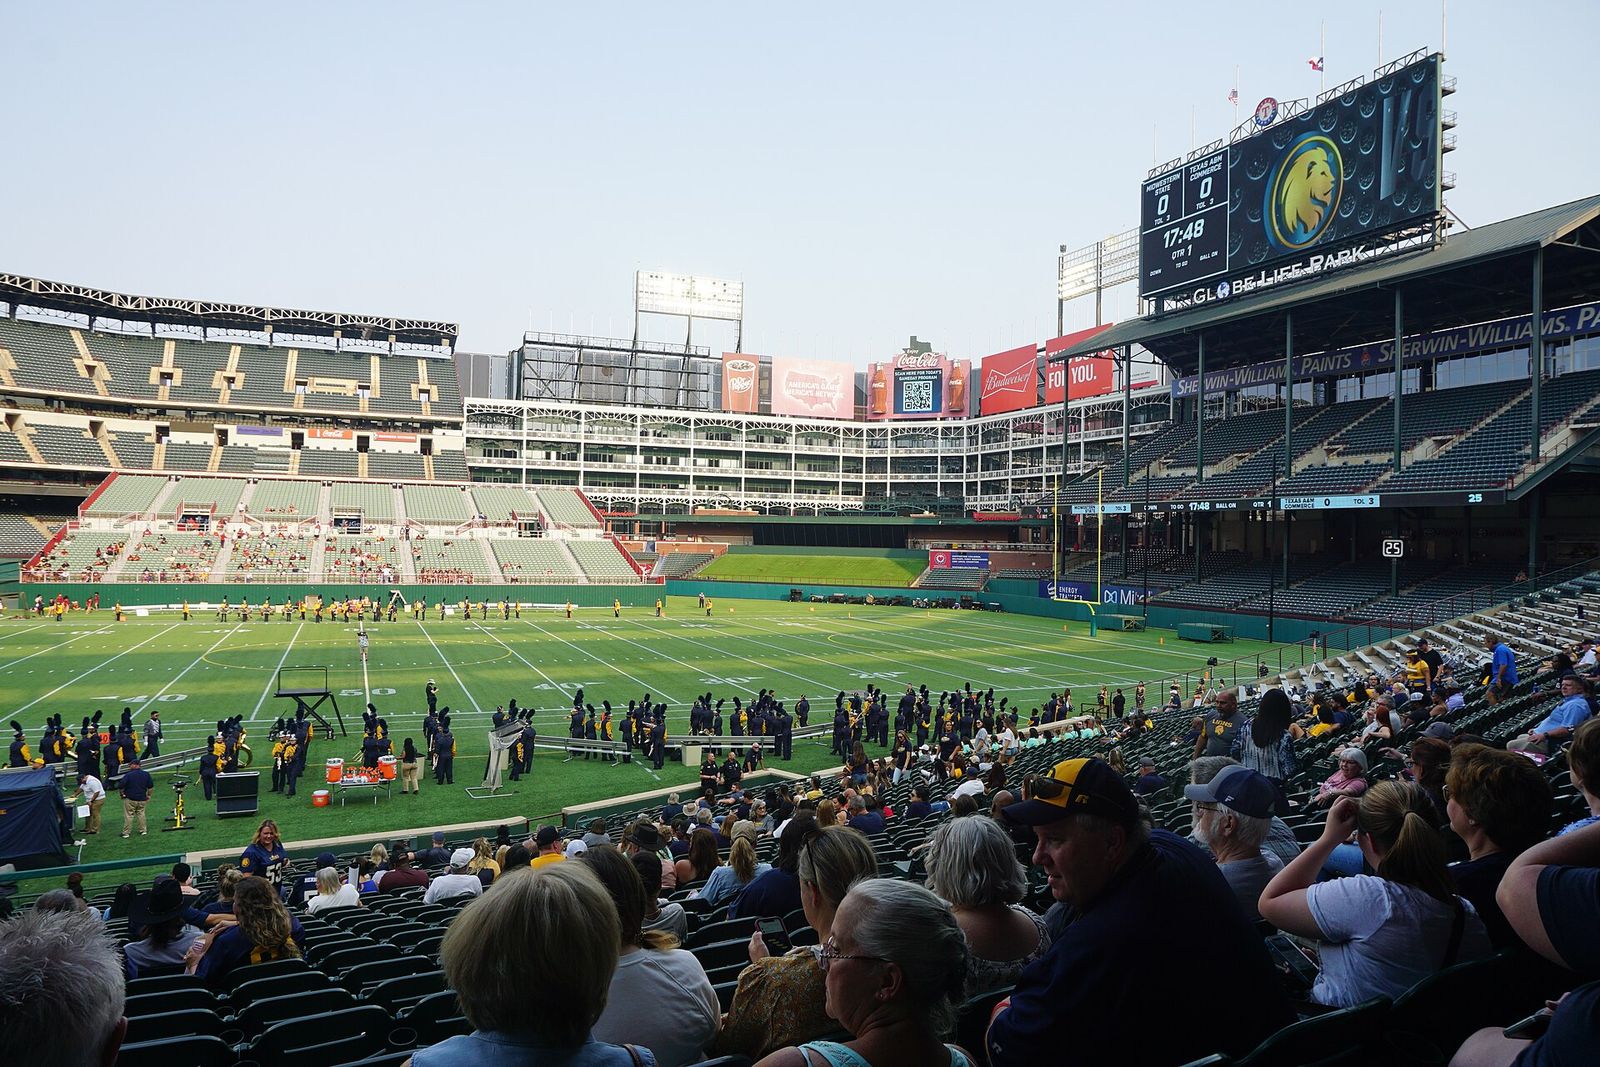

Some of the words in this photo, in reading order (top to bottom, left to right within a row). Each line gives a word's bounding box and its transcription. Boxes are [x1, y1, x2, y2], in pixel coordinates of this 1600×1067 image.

[1190, 160, 1208, 174] TEXAS
[1190, 163, 1222, 181] COMMERCE
[1146, 173, 1181, 192] MIDWESTERN
[1199, 176, 1213, 199] 0
[1154, 184, 1171, 196] STATE
[1157, 194, 1169, 216] 0
[1195, 202, 1206, 210] TOL
[1163, 219, 1205, 249] 17:48
[1187, 244, 1193, 256] 1
[1193, 274, 1255, 304] GLOBE
[1260, 262, 1303, 286] LIFE
[1309, 245, 1368, 274] PARK
[897, 352, 941, 368] Coca-Cola
[1300, 352, 1352, 376] PAINTS
[986, 371, 1031, 391] Budweiser
[1071, 363, 1097, 385] YOU.
[1266, 500, 1272, 508] 1
[1324, 498, 1331, 507] 0
[1368, 497, 1375, 505] 3
[1468, 493, 1483, 503] 25
[1188, 502, 1210, 511] 17:48
[1386, 542, 1400, 555] 25
[1059, 586, 1078, 594] ENERGY
[338, 687, 397, 697] 50
[265, 862, 282, 885] 53
